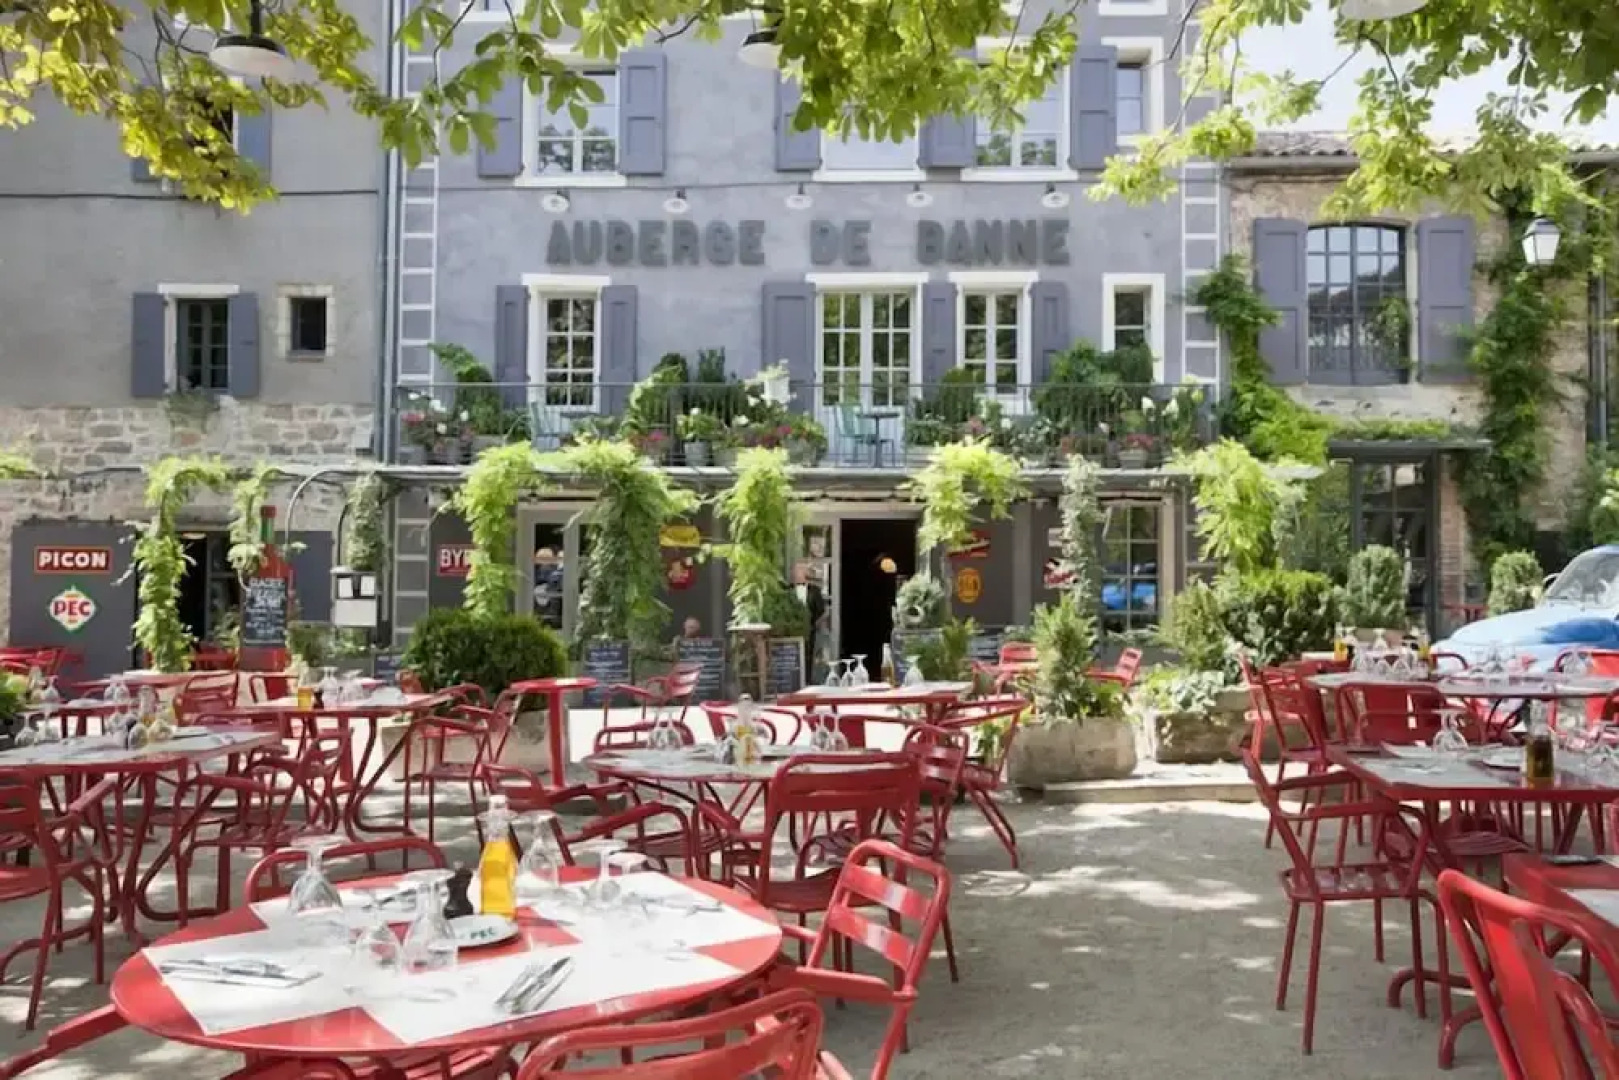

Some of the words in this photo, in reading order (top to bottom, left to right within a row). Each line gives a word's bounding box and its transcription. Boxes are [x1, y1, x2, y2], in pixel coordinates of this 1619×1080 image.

[546, 219, 766, 268] AUBERGE
[810, 219, 872, 267] DE
[917, 219, 1071, 267] BANNE
[39, 551, 106, 568] PICON
[54, 600, 91, 617] PEC
